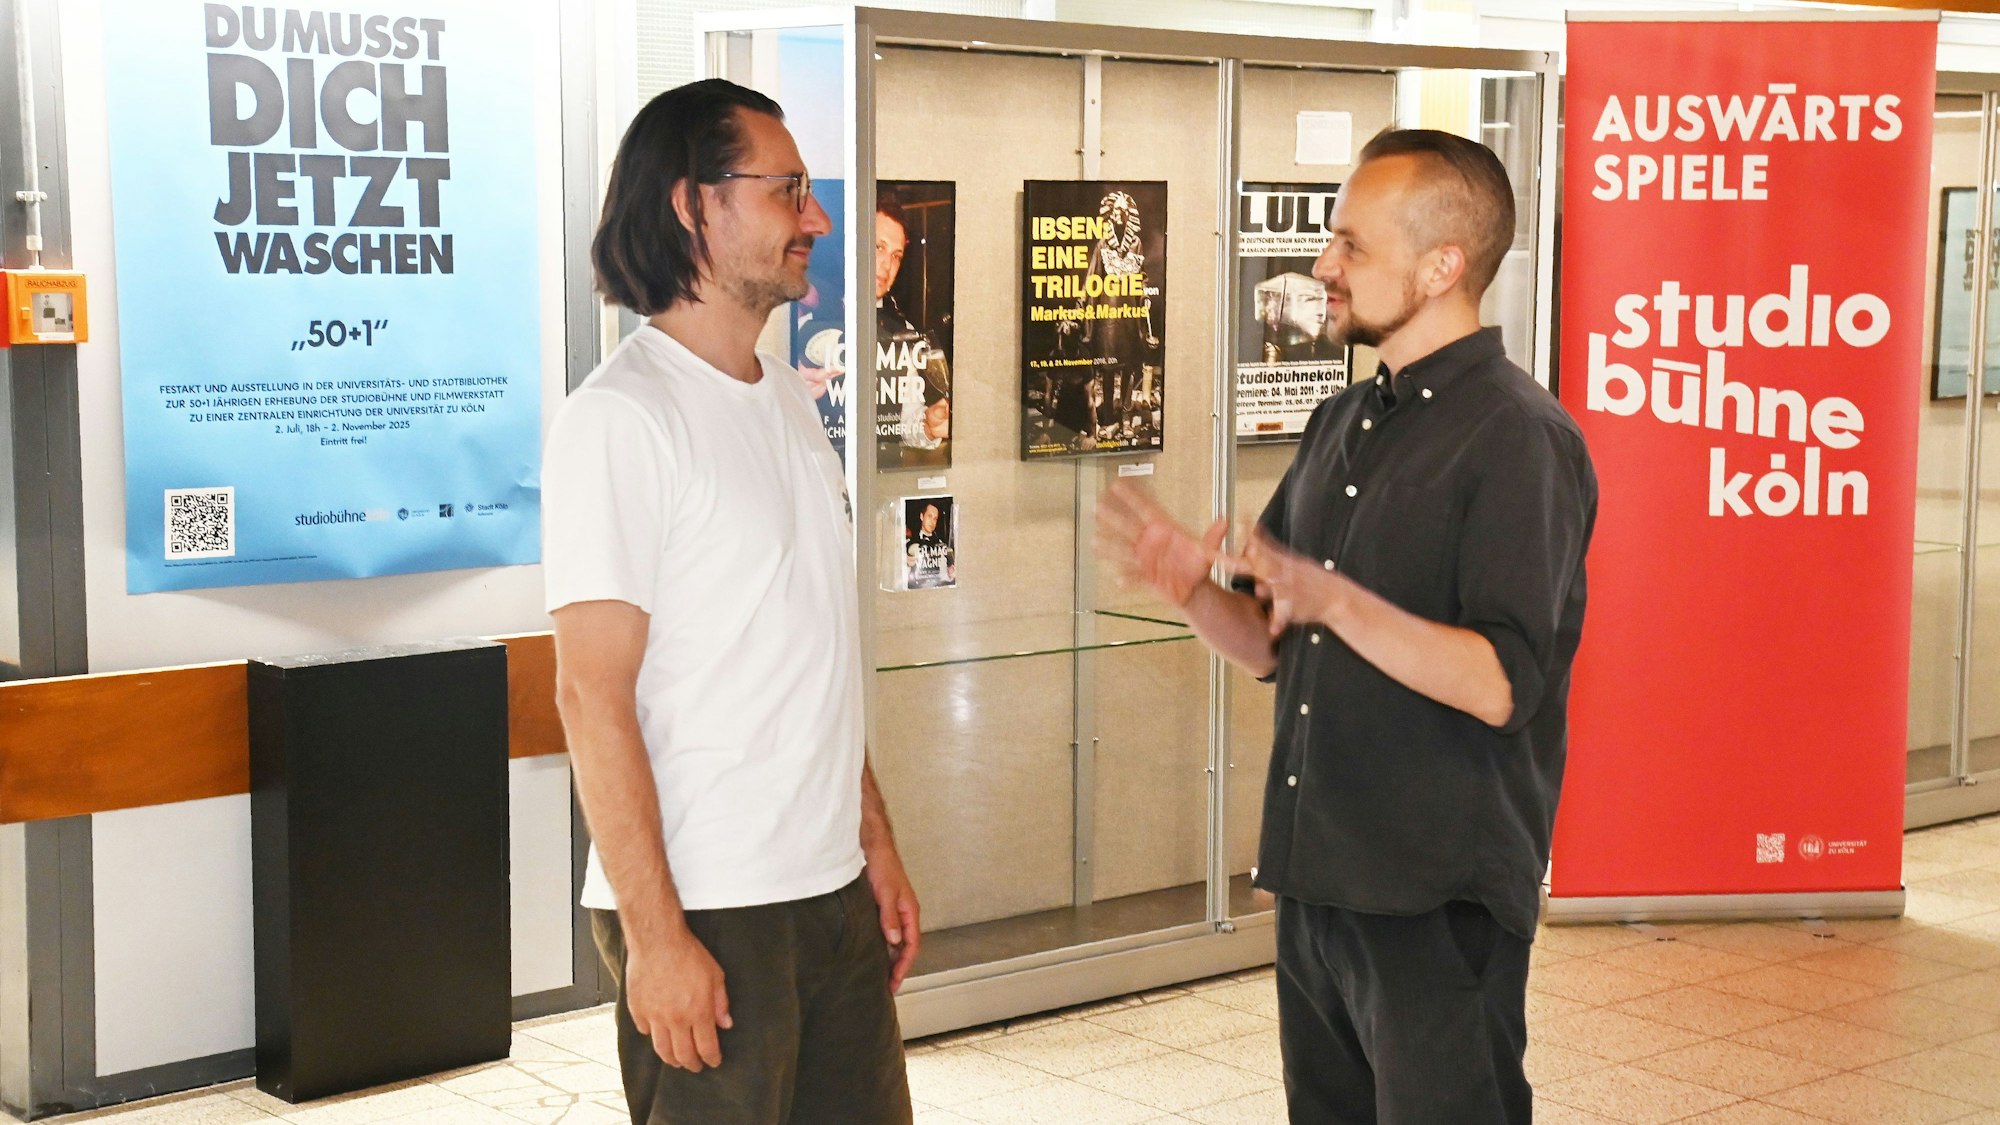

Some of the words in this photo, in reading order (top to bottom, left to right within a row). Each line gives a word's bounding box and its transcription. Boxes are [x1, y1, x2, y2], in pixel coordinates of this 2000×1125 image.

[204, 3, 277, 51] DU
[281, 8, 446, 61] MUSST
[207, 53, 450, 152] DICH
[1591, 154, 1769, 202] SPIELE
[213, 152, 451, 228] JETZT
[213, 232, 454, 275] WASCHEN
[1032, 246, 1088, 270] EINE
[27, 280, 76, 288] RAUCHABZUG
[1031, 273, 1144, 299] TRILOGIE
[1611, 264, 1891, 348] studio
[876, 341, 927, 371] MAG
[1063, 358, 1093, 366] November
[160, 384, 200, 394] FESTAKT
[204, 384, 228, 393] UND
[231, 382, 300, 392] AUSSTELLUNG
[303, 382, 313, 391] IN
[316, 381, 334, 390] DER
[338, 378, 406, 390] UNIVERSITÄTS-
[408, 378, 430, 388] UND
[432, 376, 508, 387] STADTBIBLIOTHEK
[1237, 388, 1269, 398] remiere:
[1284, 386, 1298, 396] Mai
[1300, 386, 1314, 395] 2011
[1320, 385, 1328, 394] 20
[165, 400, 186, 408] ZUR
[189, 399, 210, 408] 50+1
[212, 397, 262, 407] JÄHRIGEN
[265, 396, 317, 406] ERHEBUNG
[320, 396, 338, 404] DER
[342, 392, 408, 404] STUDIOBÜHNE
[410, 392, 431, 402] UND
[434, 390, 504, 401] FILMWERKSTATT
[189, 414, 203, 423] ZU
[206, 412, 234, 422] EINER
[238, 411, 294, 421] ZENTRALEN
[297, 408, 362, 419] EINRICHTUNG
[366, 408, 384, 416] DER
[386, 404, 444, 416] UNIVERSITÄT
[446, 404, 458, 414] ZU
[461, 402, 485, 413] KÖLN
[276, 425, 284, 434] 2.
[286, 424, 303, 435] Juli,
[306, 423, 320, 432] 18h
[331, 423, 339, 432] 2.
[342, 421, 386, 431] November
[389, 420, 410, 430] 2025
[320, 437, 348, 446] Eintritt
[350, 436, 367, 445] frei!
[295, 510, 366, 526] studiobühne
